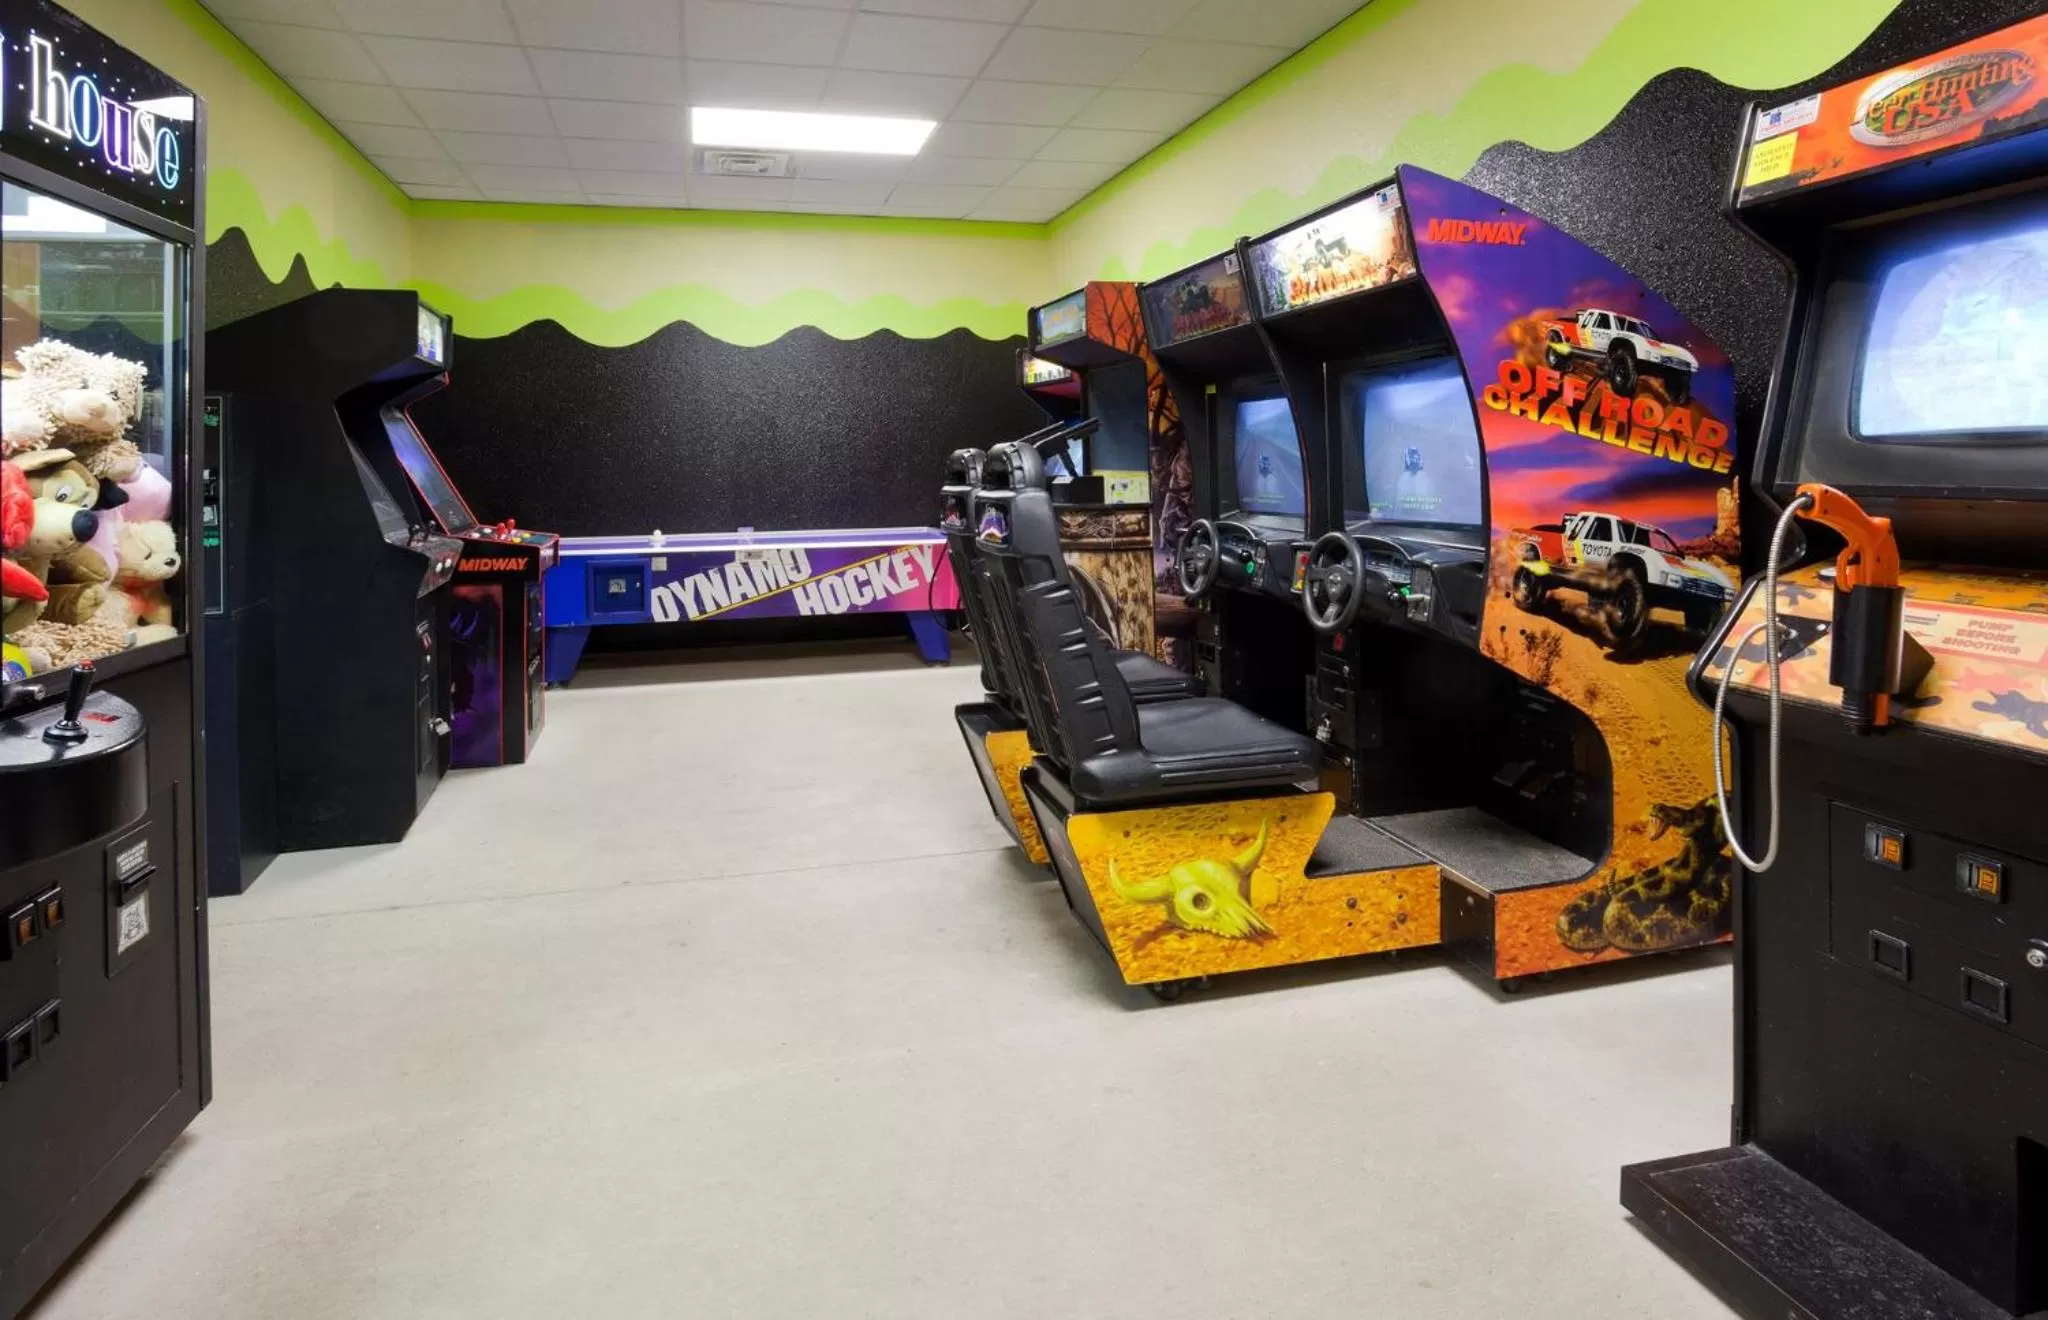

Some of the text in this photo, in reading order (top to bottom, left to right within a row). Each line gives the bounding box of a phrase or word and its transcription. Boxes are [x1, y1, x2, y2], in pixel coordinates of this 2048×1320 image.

[30, 34, 180, 190] house
[1862, 86, 1914, 119] eer
[1882, 88, 1974, 137] USA
[1428, 218, 1527, 246] MIDWAY
[1498, 359, 1730, 449] OFF ROAD
[1482, 383, 1736, 475] CHALLENGE
[458, 556, 529, 572] MIDWAY
[1581, 542, 1613, 558] TOYOTA
[651, 547, 813, 623] DYNAMO
[792, 543, 936, 616] HOCKEY
[1956, 628, 2018, 644] BEFORE
[1968, 619, 2015, 632] PUMP
[1942, 636, 2022, 656] SHOOTING
